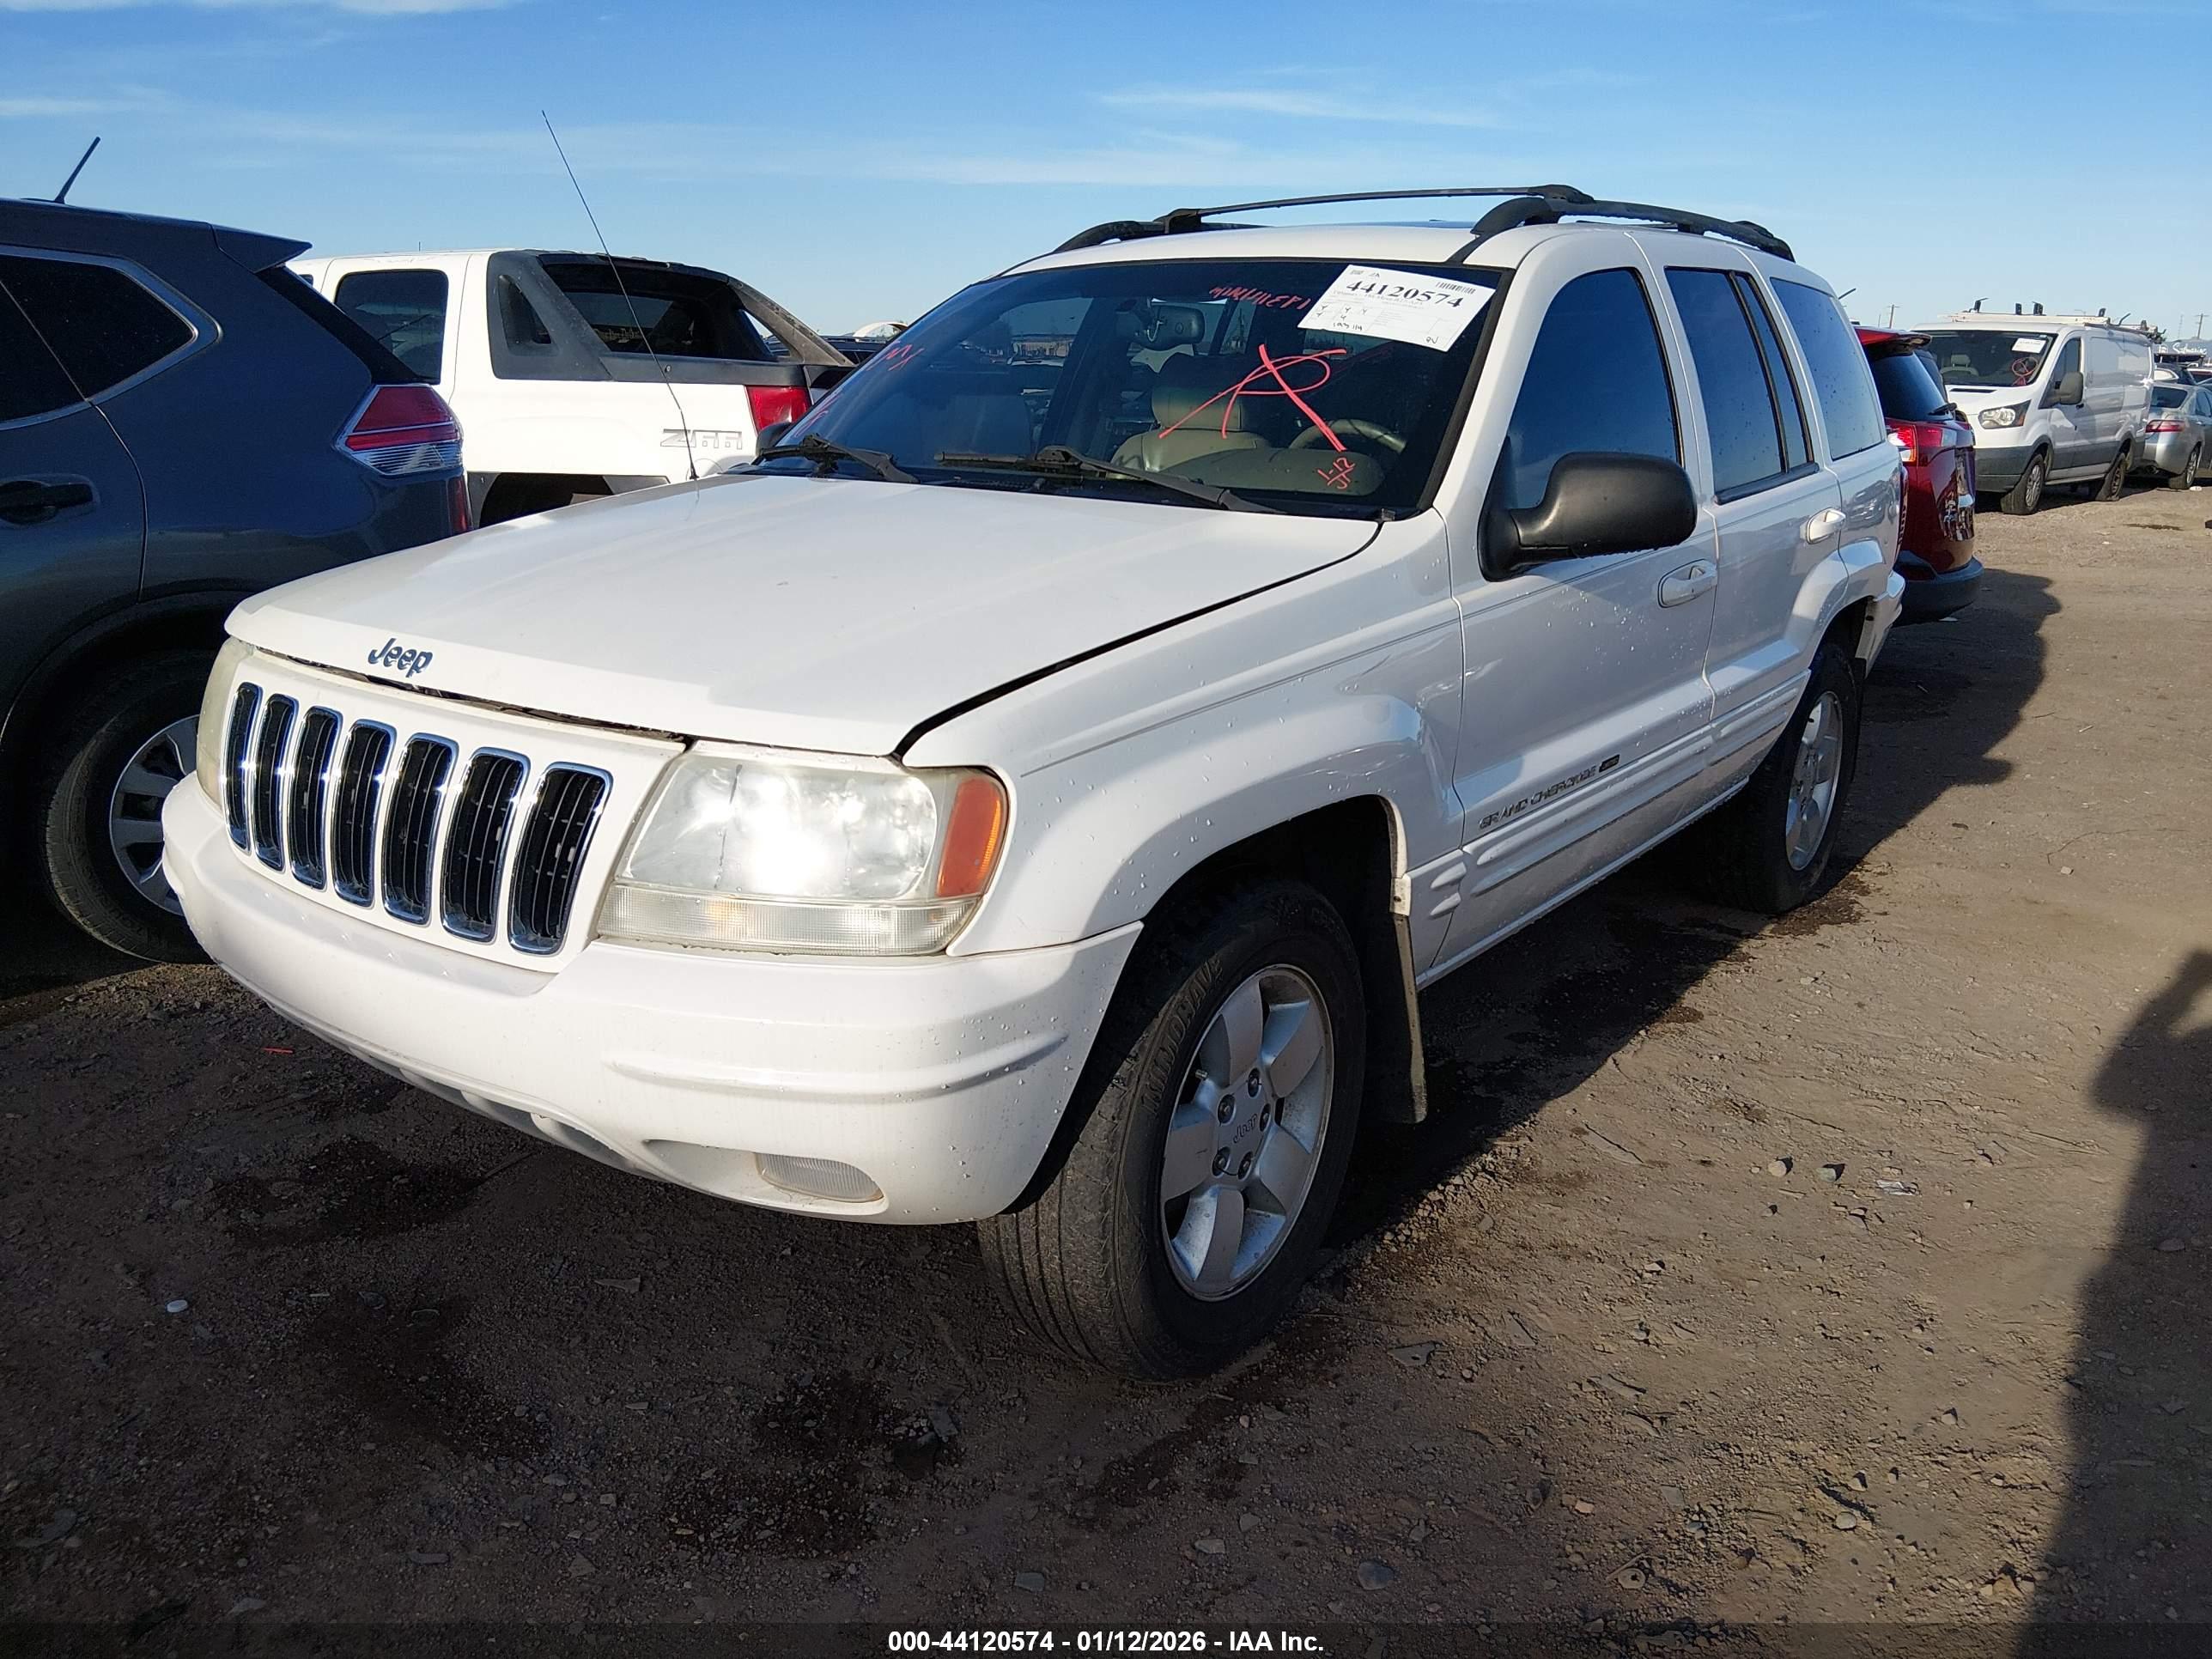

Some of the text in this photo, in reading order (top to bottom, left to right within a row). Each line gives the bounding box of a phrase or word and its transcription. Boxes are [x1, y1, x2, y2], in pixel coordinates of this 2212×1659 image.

[1346, 280, 1464, 307] 44120574
[368, 637, 434, 678] Jeep
[1479, 765, 1597, 830] GRAND CHEROKEE
